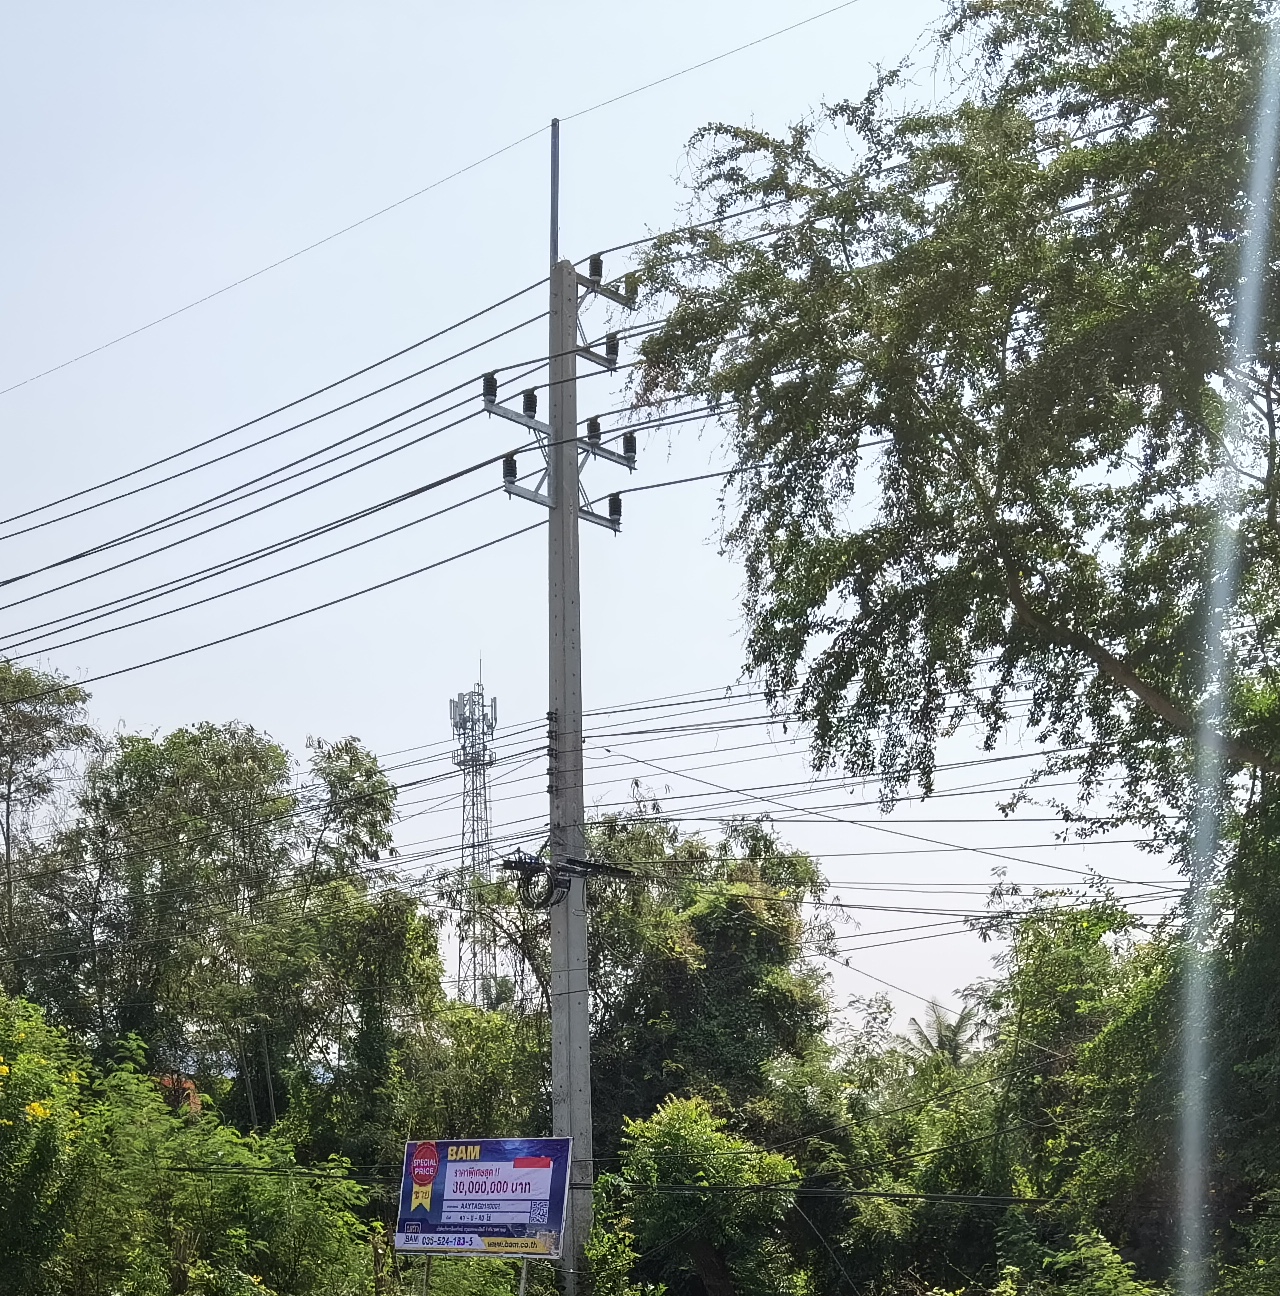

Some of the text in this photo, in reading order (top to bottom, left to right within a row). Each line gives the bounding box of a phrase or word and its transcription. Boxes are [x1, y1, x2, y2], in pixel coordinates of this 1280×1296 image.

[447, 1145, 480, 1160] BAM
[413, 1158, 437, 1167] SPECIAL
[414, 1167, 435, 1175] PRICE
[452, 1181, 531, 1196] 30,000,000 บาท
[414, 1190, 430, 1200] ขาย
[487, 1240, 538, 1249] www.bam.co.th
